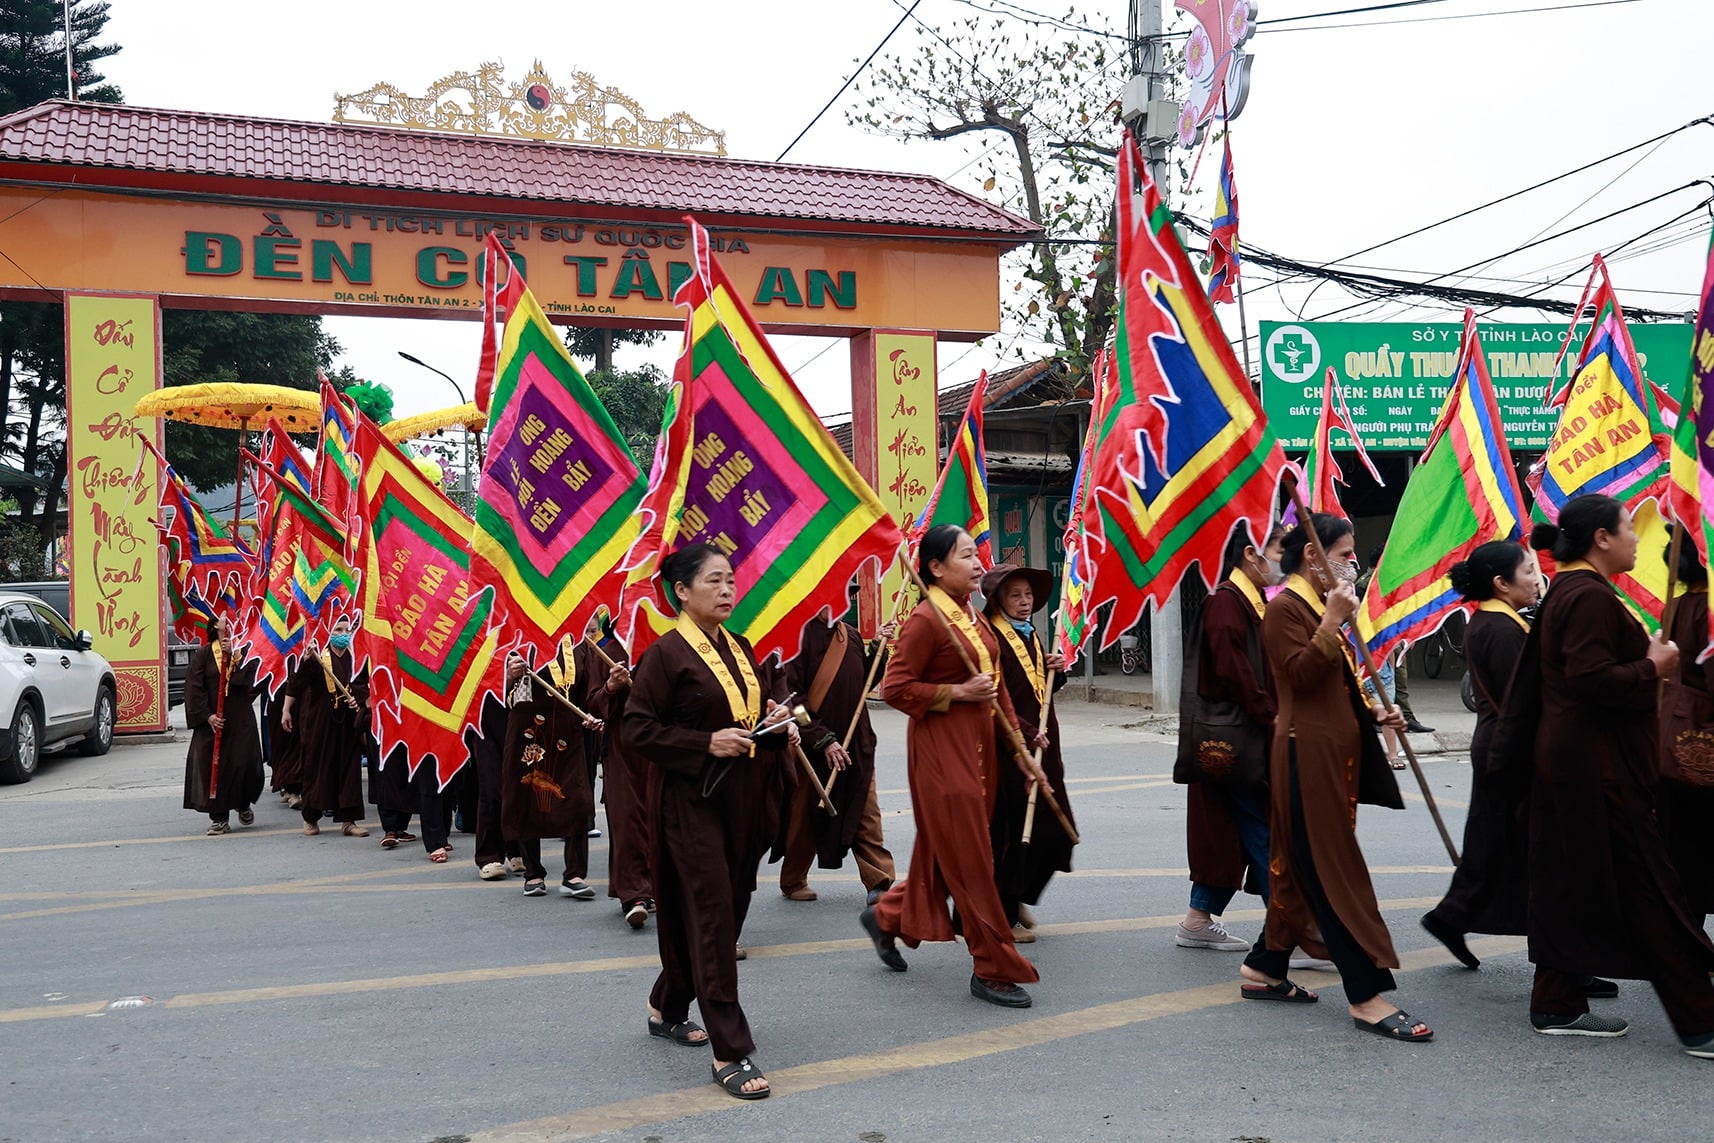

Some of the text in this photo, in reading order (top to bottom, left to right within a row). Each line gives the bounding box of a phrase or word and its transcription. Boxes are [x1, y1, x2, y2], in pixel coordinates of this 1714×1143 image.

[181, 212, 373, 285] ĐỀN
[753, 265, 857, 310] AN
[334, 291, 355, 303] ĐỊA
[383, 293, 415, 305] THÔN
[417, 294, 441, 306] TÂN
[443, 297, 460, 307] AN
[463, 299, 470, 307] 2
[547, 300, 572, 312] TỈNH
[575, 302, 596, 313] LÀO
[598, 305, 616, 314] CAI
[1412, 326, 1436, 342] SỞ
[1440, 331, 1450, 342] Y
[1479, 326, 1517, 342] TỈNH
[1521, 327, 1554, 342] LÀO
[889, 348, 921, 386] Tân
[1410, 346, 1461, 378] THU
[1487, 351, 1562, 378] THANH
[891, 394, 918, 420] An
[1303, 384, 1369, 399] CHYÊN:
[1372, 384, 1405, 399] BÁN
[1491, 384, 1510, 399] ÂN
[1587, 390, 1624, 420] HÀ
[1388, 405, 1413, 416] NGÀY
[1354, 420, 1387, 433] NGƯỜI
[1389, 422, 1412, 435] PHỤ
[1414, 420, 1435, 433] TRÁ
[528, 427, 575, 475] HOÀNG
[1557, 417, 1642, 476] TÂN AN
[705, 450, 755, 504] HOÀNG
[392, 563, 449, 641] BẢO HÀ
[419, 579, 469, 658] TÂN AN
